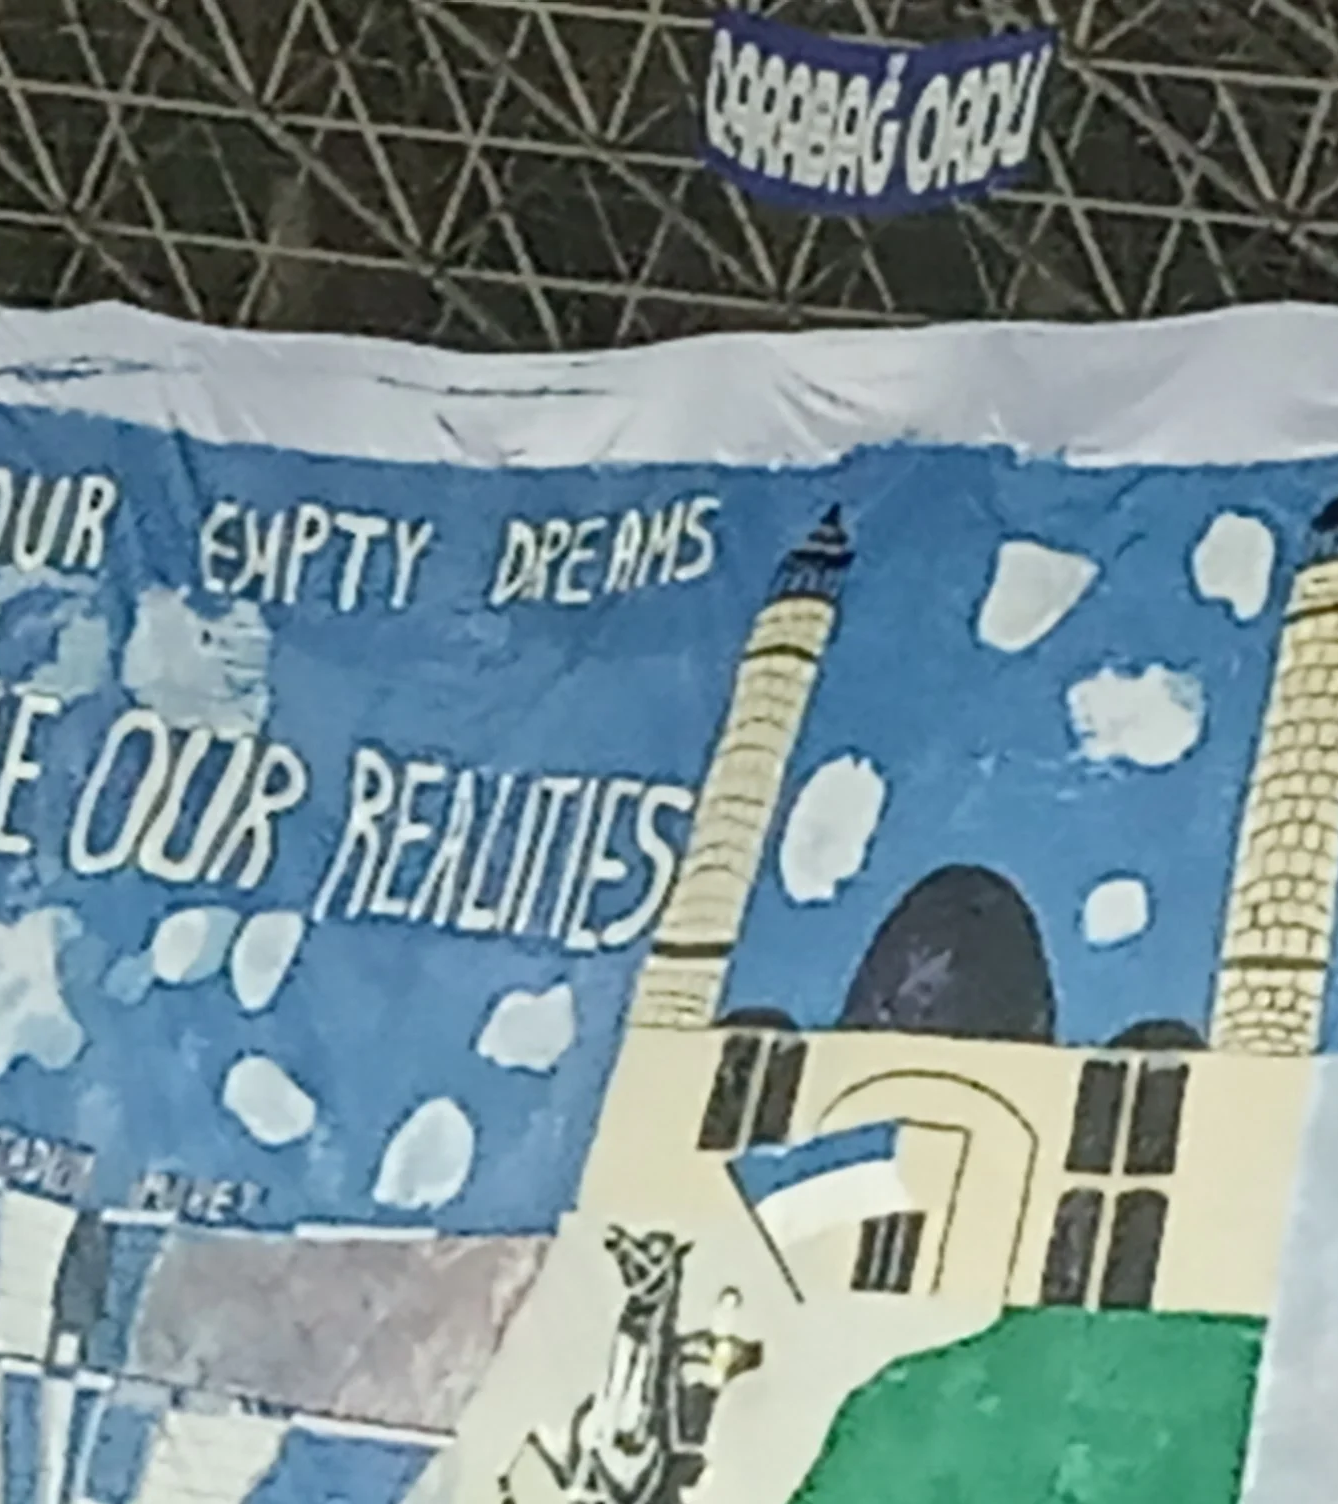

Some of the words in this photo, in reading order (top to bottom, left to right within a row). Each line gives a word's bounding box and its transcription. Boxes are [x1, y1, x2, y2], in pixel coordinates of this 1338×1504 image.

[905, 43, 1053, 195] ORDU
[198, 499, 434, 612] EMPTY
[487, 496, 723, 605] DREAMS
[68, 708, 308, 890] OUR
[311, 747, 695, 951] REALITIES
